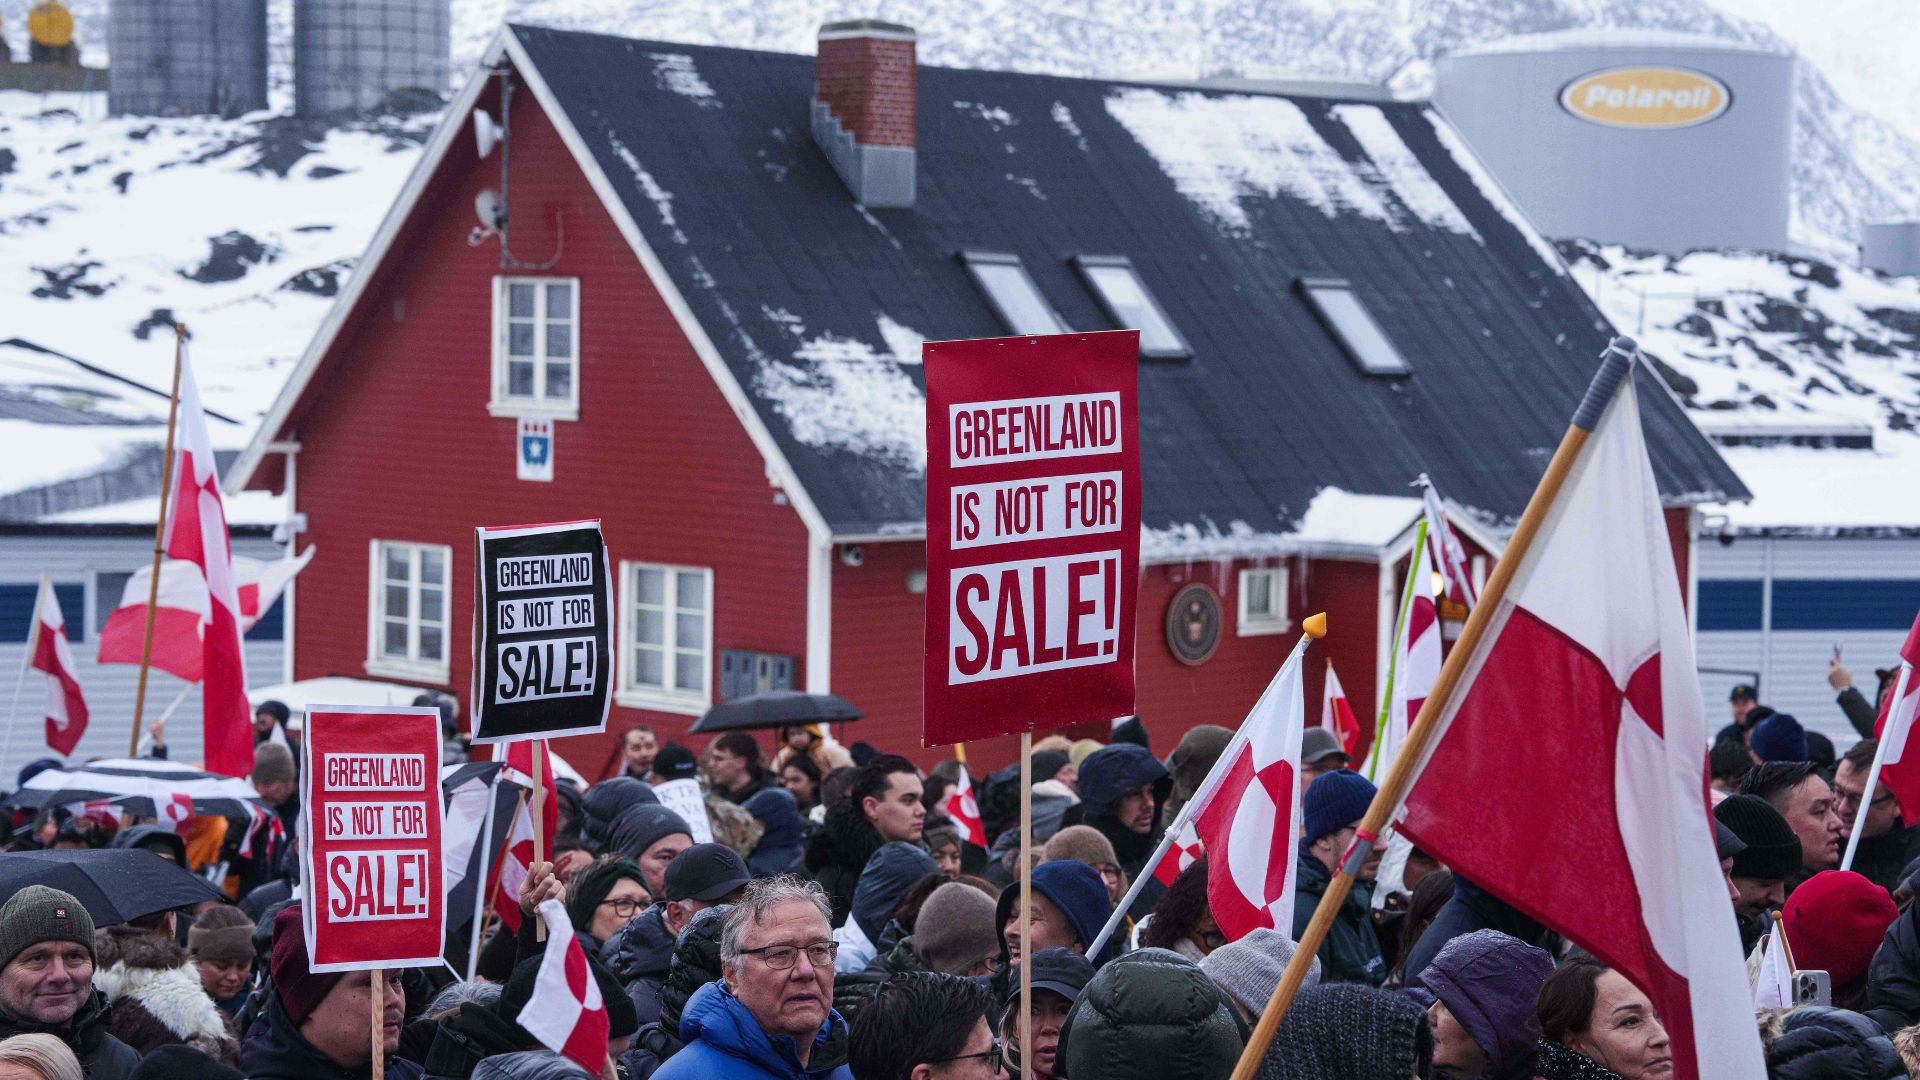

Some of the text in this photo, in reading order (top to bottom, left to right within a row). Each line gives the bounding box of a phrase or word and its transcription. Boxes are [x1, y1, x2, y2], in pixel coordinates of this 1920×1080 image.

[955, 399, 1117, 460] GREENLAND
[956, 478, 1117, 542] IS NOT FOR
[500, 557, 590, 588] GREENLAND
[500, 599, 592, 630] IS NOT FOR
[954, 558, 1117, 676] SALE!
[499, 641, 594, 700] SALE!
[327, 757, 422, 787] GREENLAND
[327, 805, 424, 836] IS NOT FOR
[330, 854, 426, 918] SALE!
